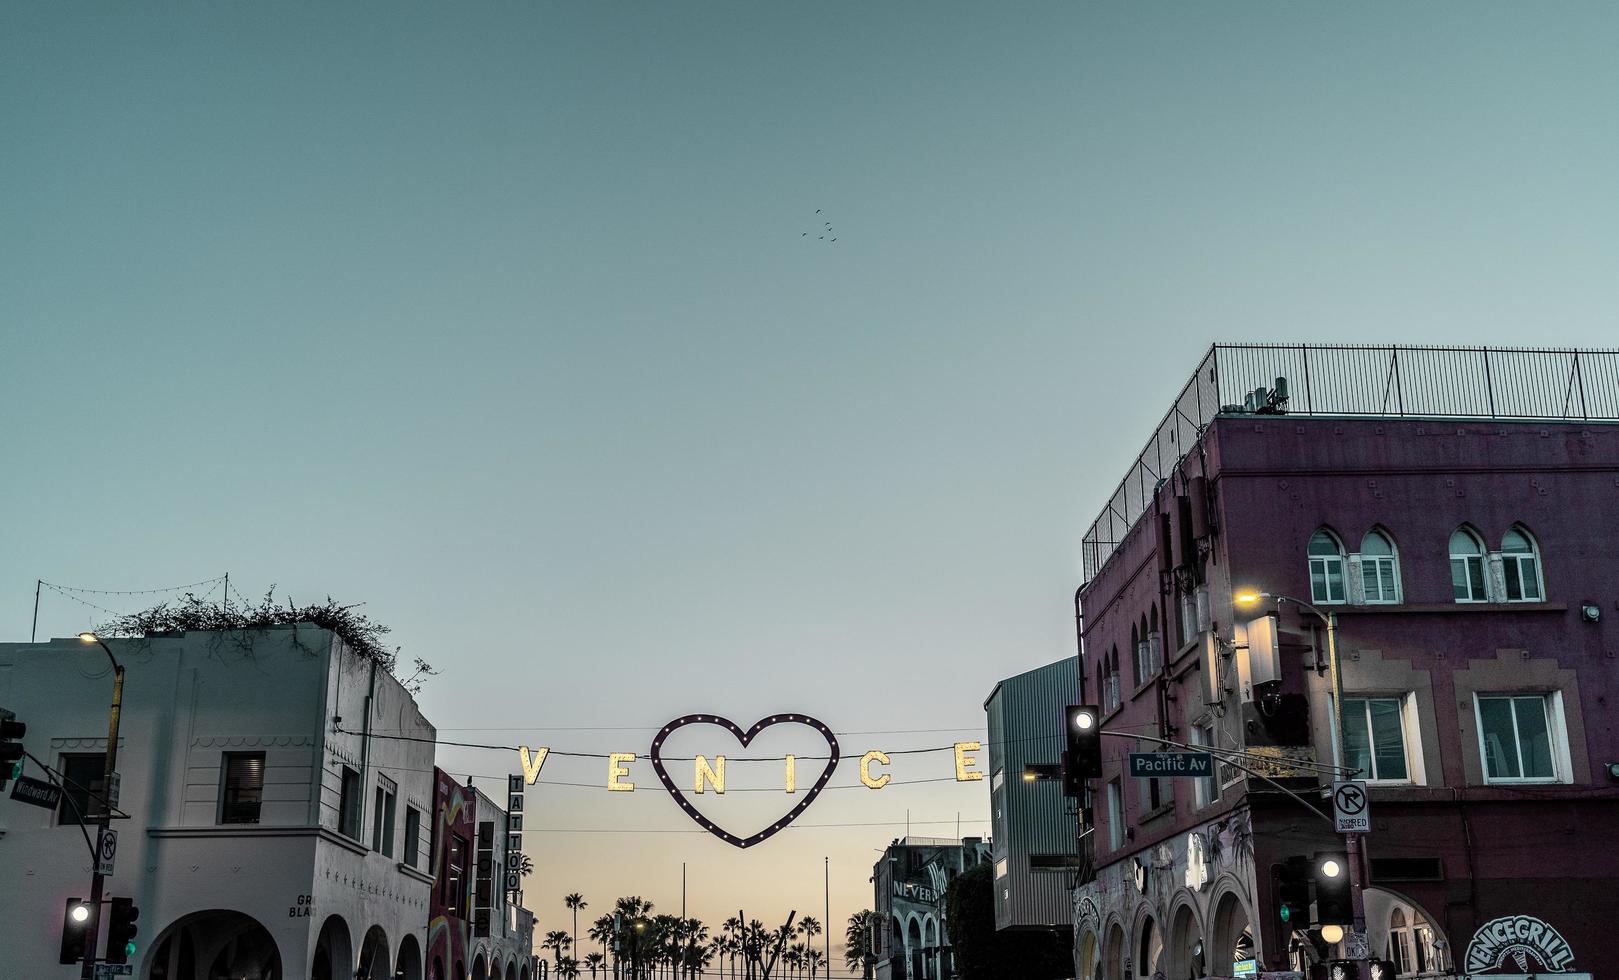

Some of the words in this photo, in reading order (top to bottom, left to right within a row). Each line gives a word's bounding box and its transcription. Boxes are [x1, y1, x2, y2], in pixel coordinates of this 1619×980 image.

[519, 740, 983, 794] VENICE
[1136, 757, 1185, 771] Pacific
[1189, 757, 1207, 771] Av
[511, 777, 521, 887] TATTOO
